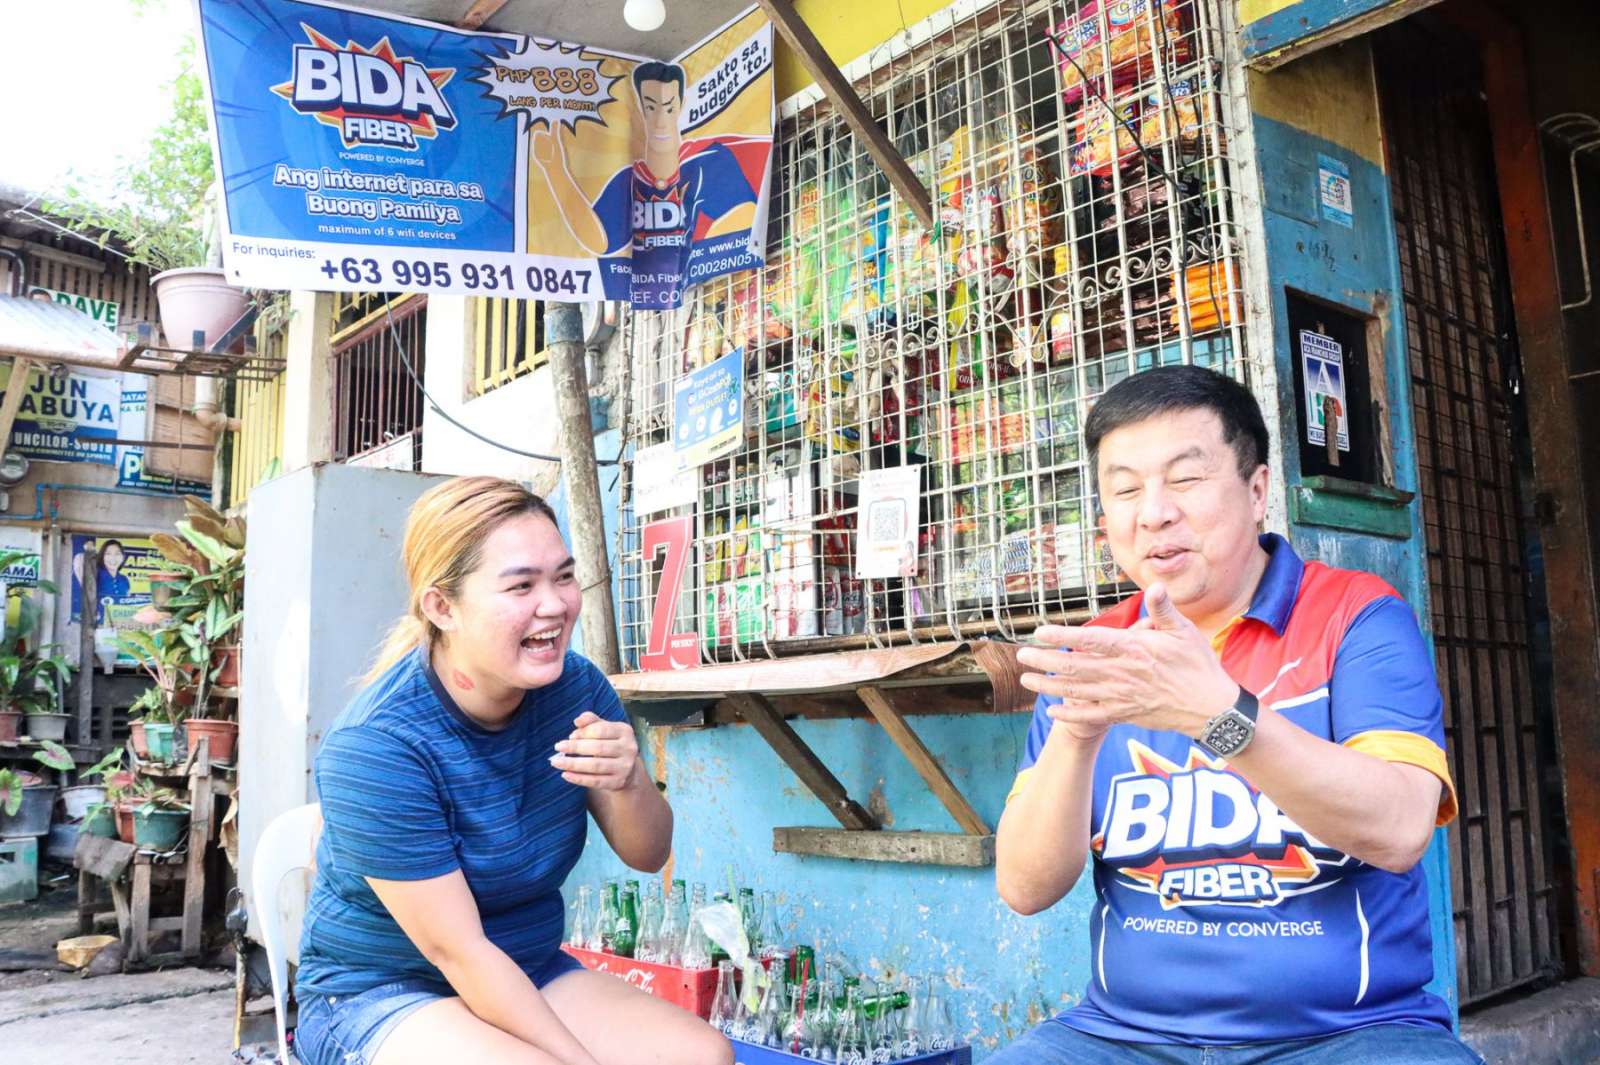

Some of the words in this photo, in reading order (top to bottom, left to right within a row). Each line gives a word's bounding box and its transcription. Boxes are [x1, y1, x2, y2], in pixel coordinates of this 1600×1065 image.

[530, 66, 599, 96] 888
[697, 57, 739, 99] Sakto
[741, 39, 760, 62] sa
[294, 47, 456, 124] BIDA
[688, 72, 740, 124] budget
[508, 95, 537, 108] LANG
[539, 96, 562, 109] PER
[344, 117, 414, 147] FIBER
[339, 151, 374, 163] POWERED
[374, 154, 385, 163] BY
[386, 155, 425, 166] CONVERGE
[273, 165, 319, 189] Ang
[322, 168, 408, 195] internet
[410, 181, 457, 199] para
[458, 183, 483, 200] sa
[307, 195, 378, 220] Buong
[380, 200, 461, 225] Pamilya
[318, 224, 372, 237] maximum
[374, 227, 385, 237] of
[387, 227, 394, 237] 6
[396, 228, 416, 238] wifi
[417, 229, 457, 240] devices
[708, 235, 751, 254] www.bid
[232, 241, 254, 255] For
[256, 244, 317, 259] inquiries:
[689, 252, 763, 278] C0028N05
[320, 256, 383, 285] +63
[391, 259, 453, 288] 995
[461, 262, 515, 291] 931
[525, 265, 593, 295] 0847
[658, 289, 682, 304] CO
[1303, 334, 1340, 353] MEMBER
[30, 373, 87, 400] JUN
[0, 391, 114, 423] ABUYA
[641, 517, 688, 656] 7
[1161, 865, 1273, 900] FIBER
[1123, 917, 1198, 936] POWERED
[1202, 921, 1222, 937] BY
[1226, 920, 1324, 937] CONVERGE
